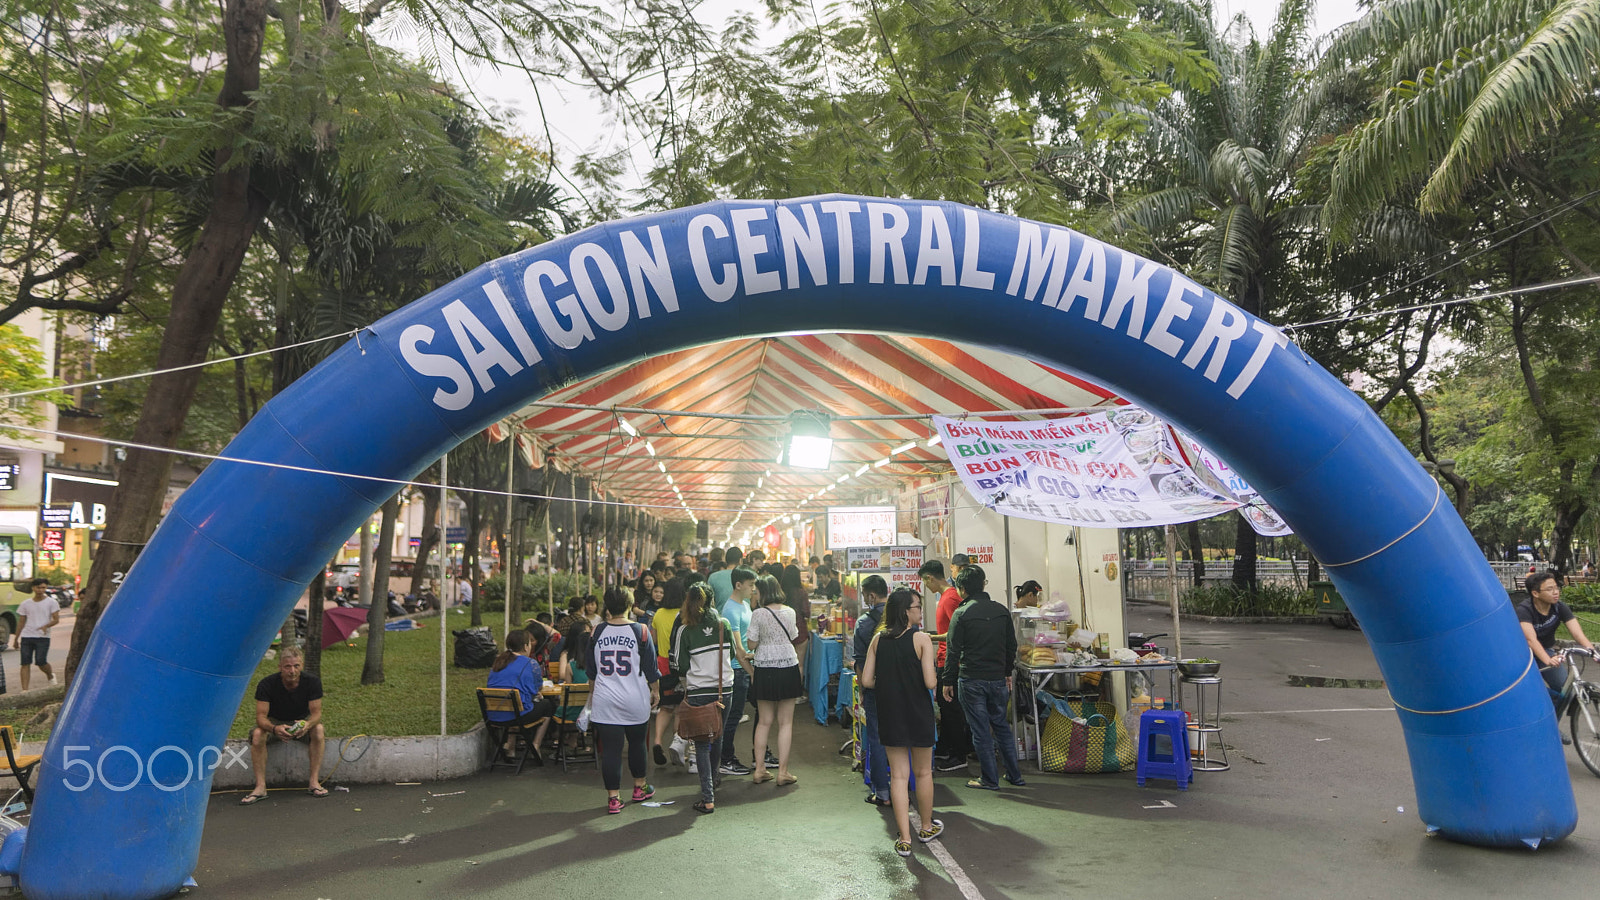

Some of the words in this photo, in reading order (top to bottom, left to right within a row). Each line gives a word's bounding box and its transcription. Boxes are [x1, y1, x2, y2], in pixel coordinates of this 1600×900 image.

[687, 201, 996, 302] CENTRAL
[1005, 221, 1289, 400] MAKERT
[965, 456, 1022, 475] BÚN
[1086, 461, 1138, 479] CUA
[1038, 475, 1081, 499] GIÒ
[863, 559, 879, 569] 25K
[905, 558, 921, 569] 30K
[979, 554, 994, 564] 20K
[597, 635, 636, 649] POWERS
[600, 650, 632, 676] 55
